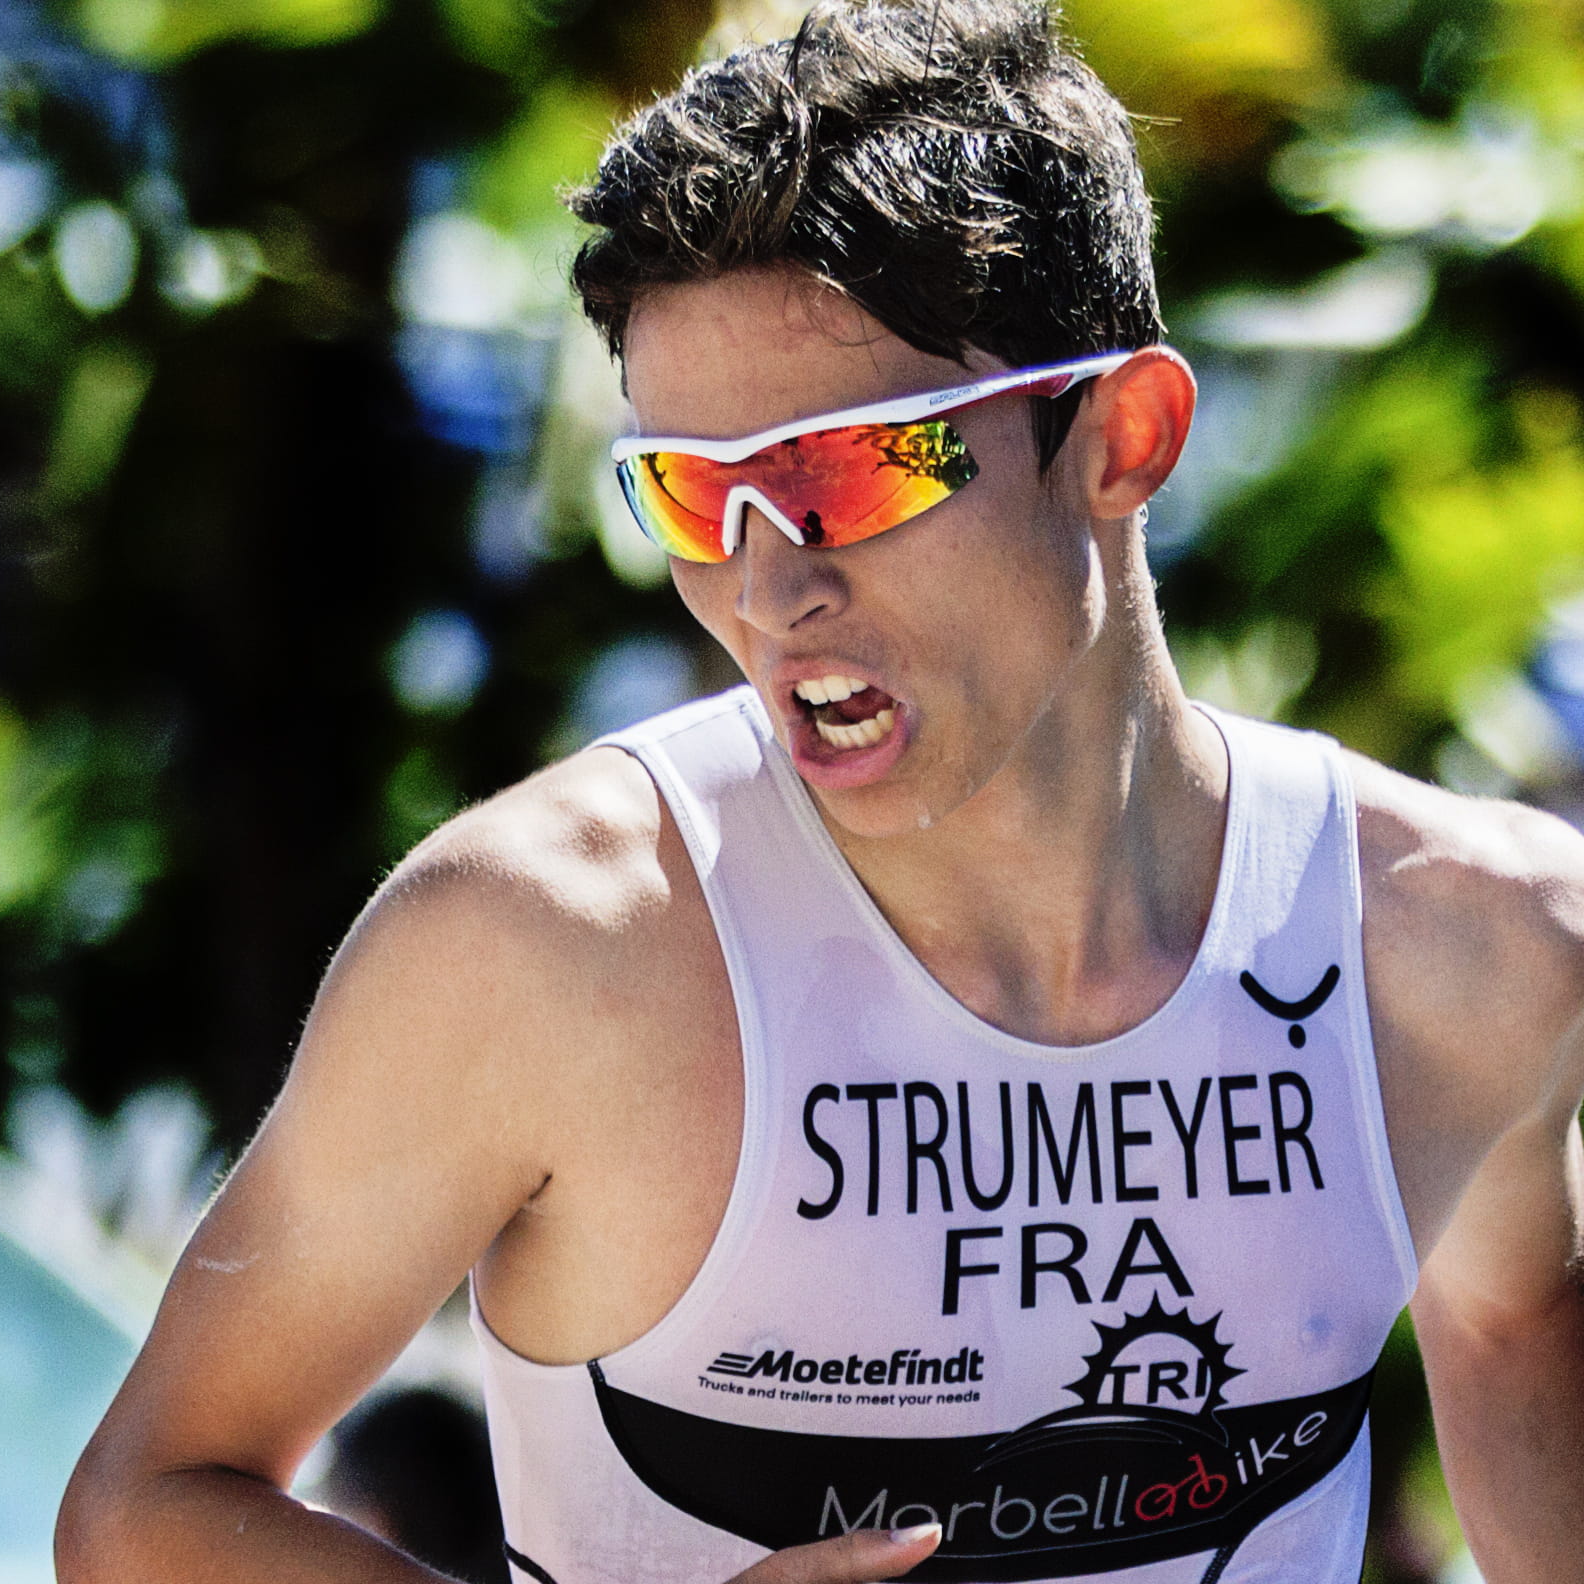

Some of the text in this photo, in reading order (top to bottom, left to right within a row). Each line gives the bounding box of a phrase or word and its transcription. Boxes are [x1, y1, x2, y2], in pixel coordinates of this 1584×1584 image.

[796, 1070, 1325, 1220] STRUMEYER
[941, 1216, 1194, 1316] FRA
[742, 1347, 984, 1385] Moetefindt
[1110, 1357, 1207, 1405] TRI
[697, 1375, 981, 1408] Trucks and trailers to meet your needs
